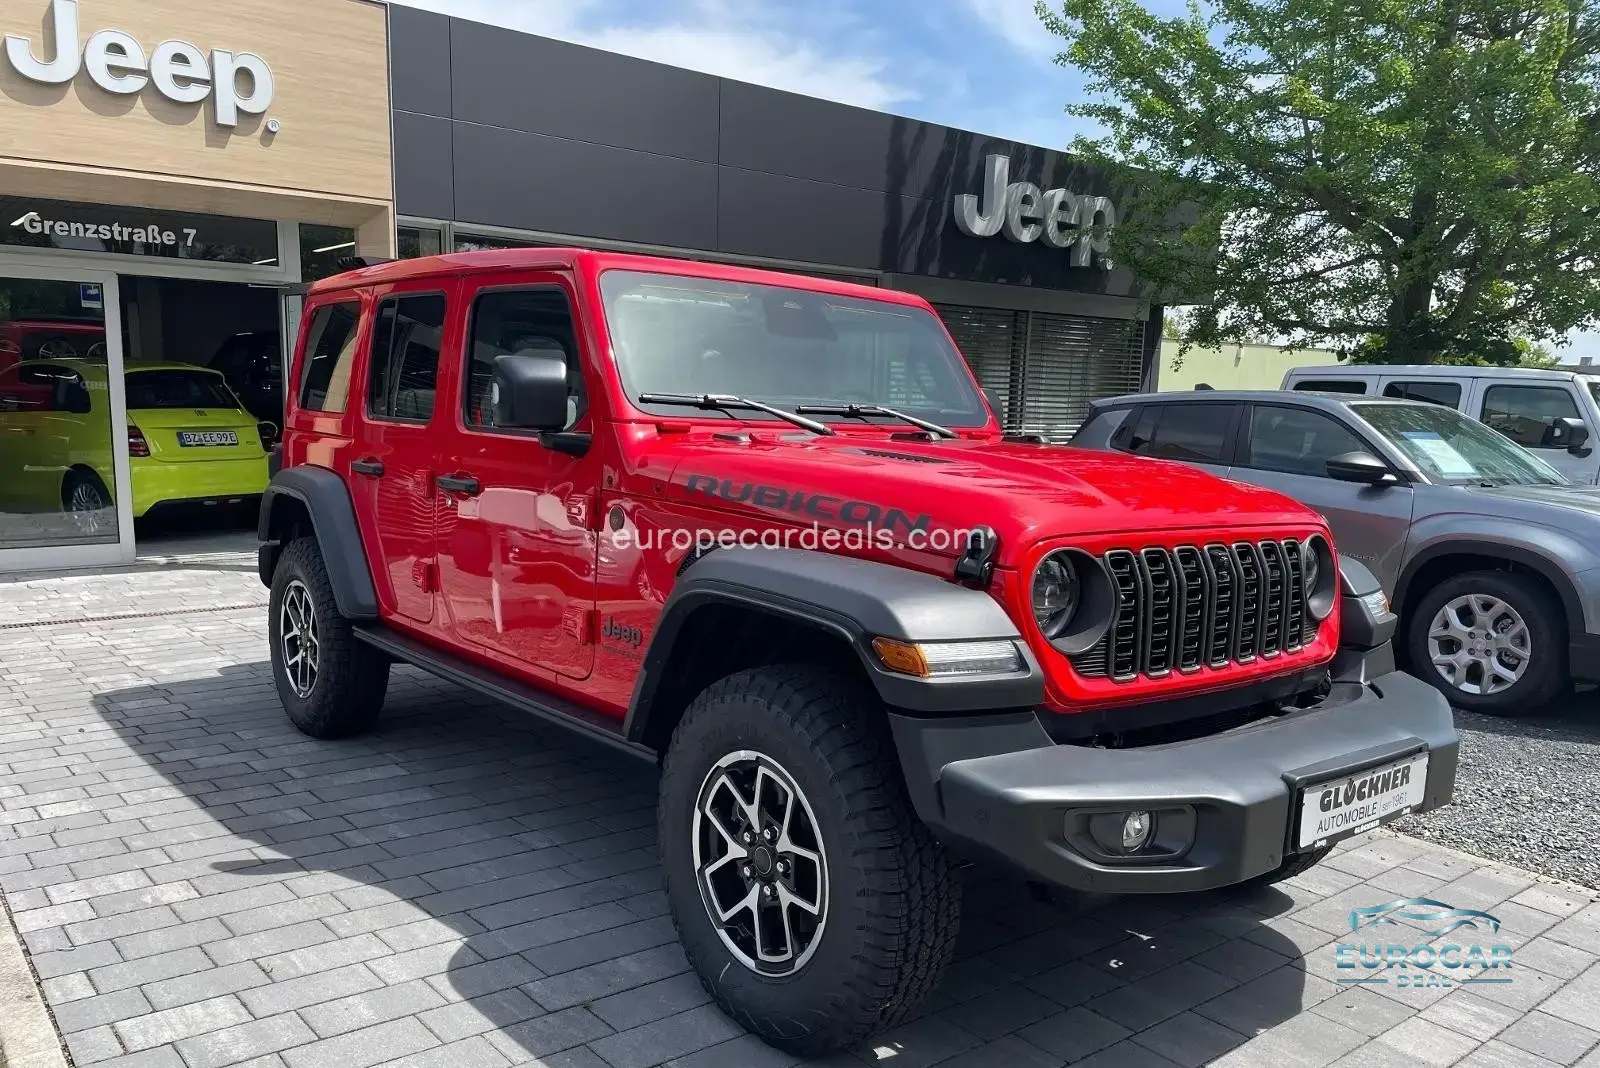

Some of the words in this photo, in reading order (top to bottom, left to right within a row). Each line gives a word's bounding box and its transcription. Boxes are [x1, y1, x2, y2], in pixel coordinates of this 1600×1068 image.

[5, 0, 275, 127] Jeep
[22, 211, 176, 246] Grenzstraße
[182, 228, 197, 247] 7
[953, 153, 1116, 267] Jeep
[687, 474, 933, 534] RUBICON
[602, 616, 643, 649] Jeep
[1320, 764, 1411, 813] GLÖCKNER
[1316, 801, 1378, 834] AUTOMOBILE
